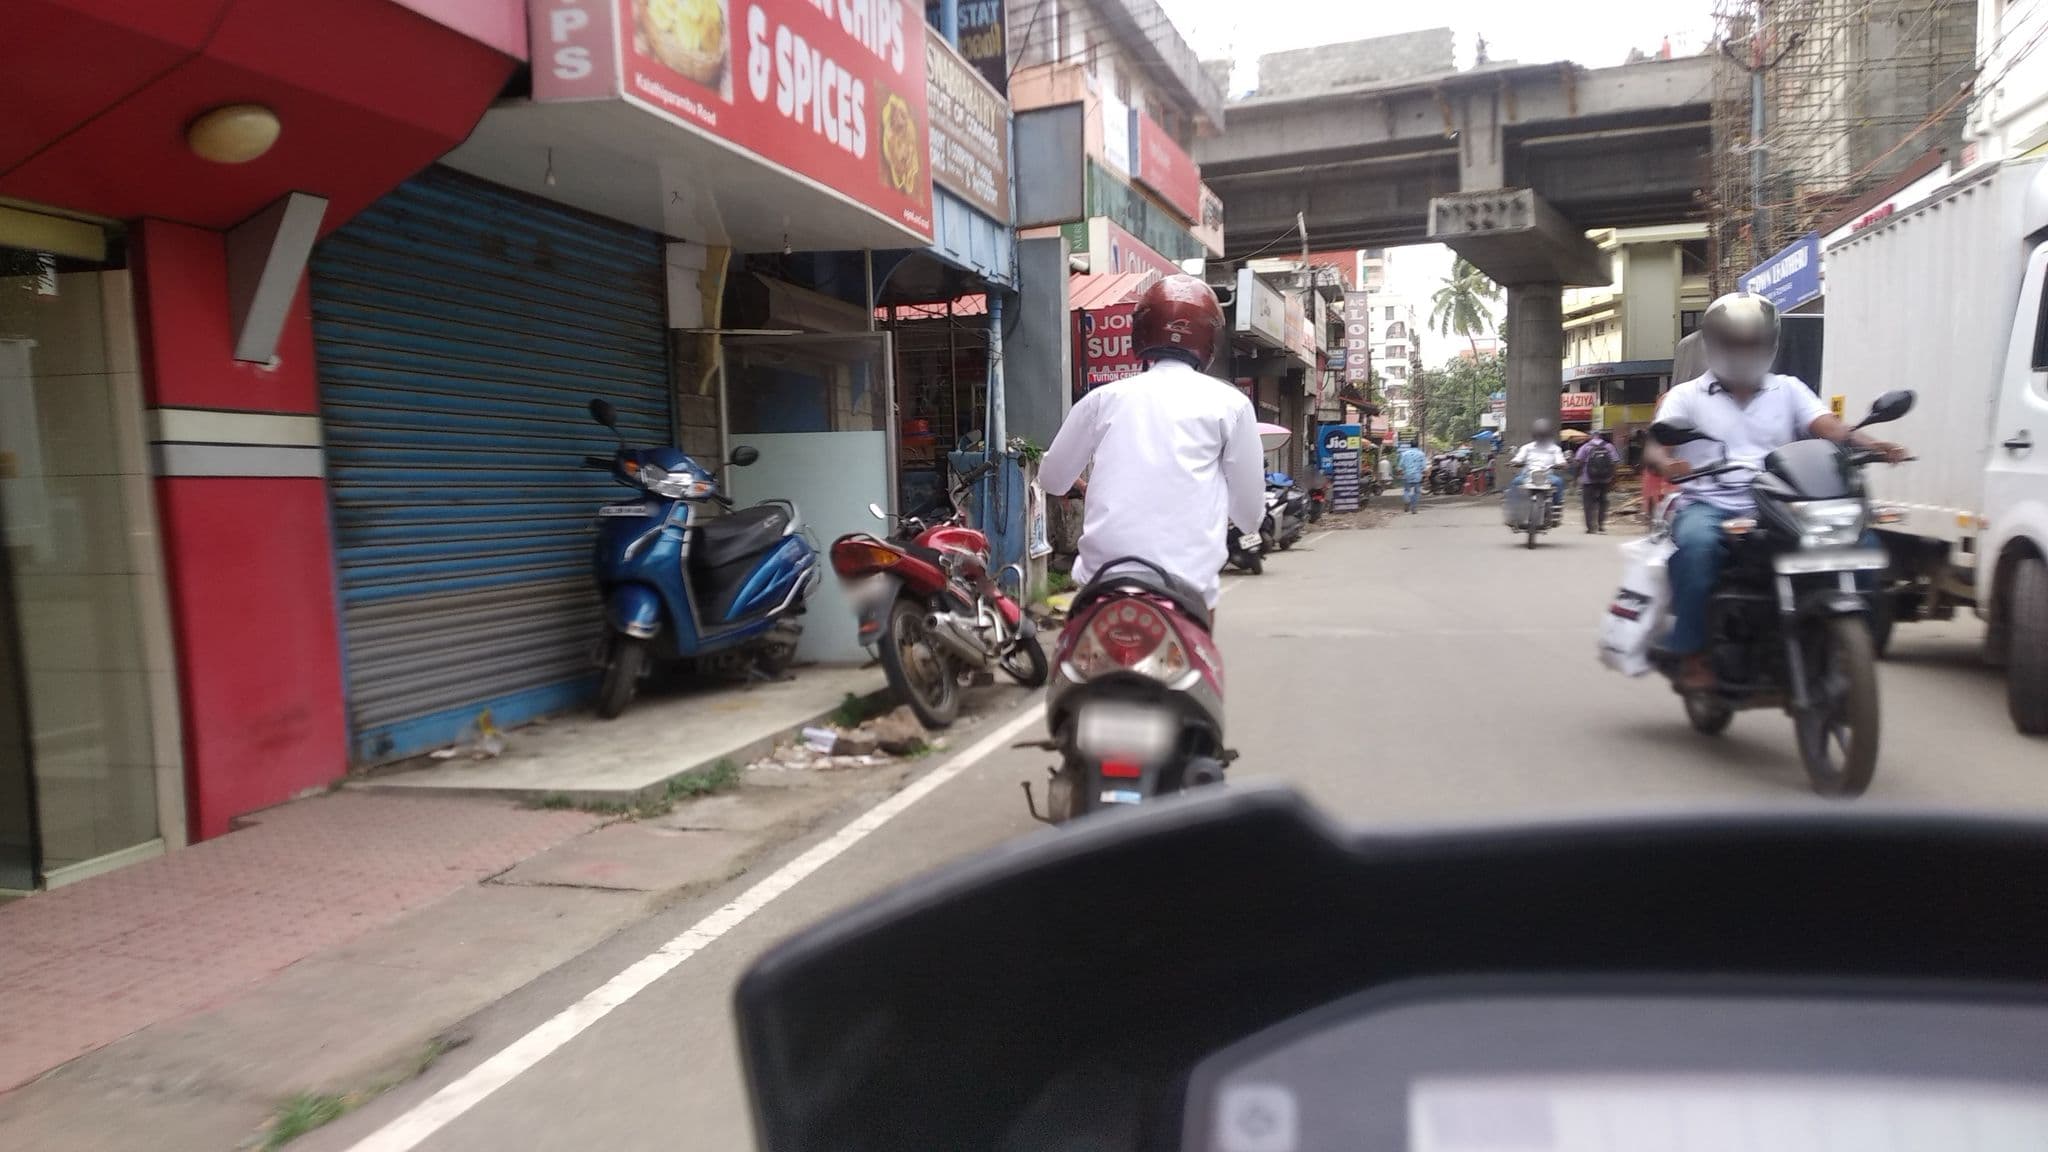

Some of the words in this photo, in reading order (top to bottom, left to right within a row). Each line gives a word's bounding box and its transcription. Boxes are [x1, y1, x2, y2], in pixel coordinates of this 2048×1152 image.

[746, 5, 771, 103] &
[775, 24, 867, 160] SPICES
[1347, 309, 1366, 380] LODGE
[1325, 436, 1348, 449] Jio
